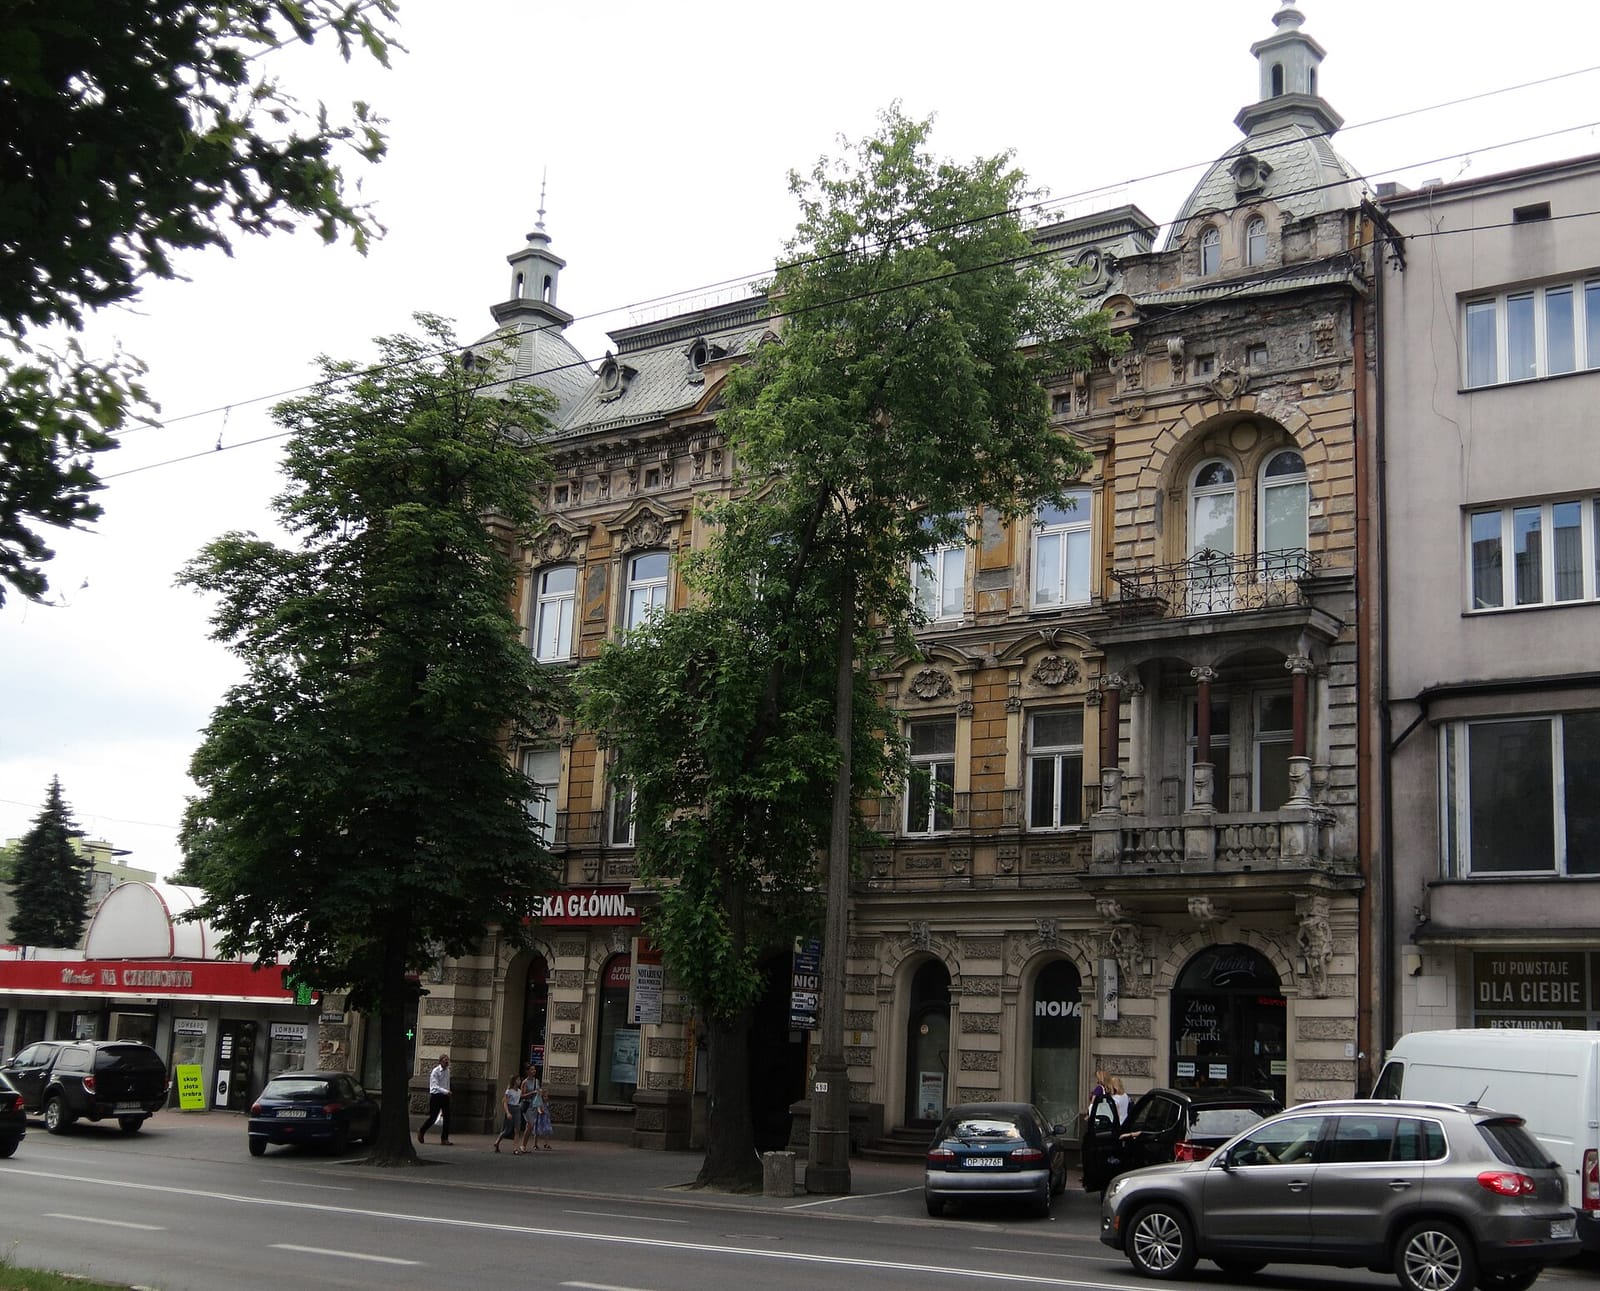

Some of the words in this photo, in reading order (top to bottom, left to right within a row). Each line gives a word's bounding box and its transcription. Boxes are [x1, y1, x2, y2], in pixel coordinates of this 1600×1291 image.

[612, 966, 631, 974] APTE
[1491, 961, 1506, 975] TU
[1509, 961, 1569, 975] POWSTAJE
[101, 969, 117, 986] NA
[123, 970, 193, 988] CZERWONYM
[611, 973, 631, 981] GŁÓW
[794, 974, 819, 988] NICI
[1480, 982, 1515, 1002] DLA
[1520, 982, 1581, 1003] CIEBIE
[1035, 1000, 1082, 1017] NOVA
[1187, 999, 1216, 1013] Złoto
[178, 1021, 205, 1029] LOMBARD
[1184, 1014, 1217, 1027] Srebro
[275, 1026, 305, 1034] LOMBARD
[1181, 1028, 1221, 1044] Zegarki
